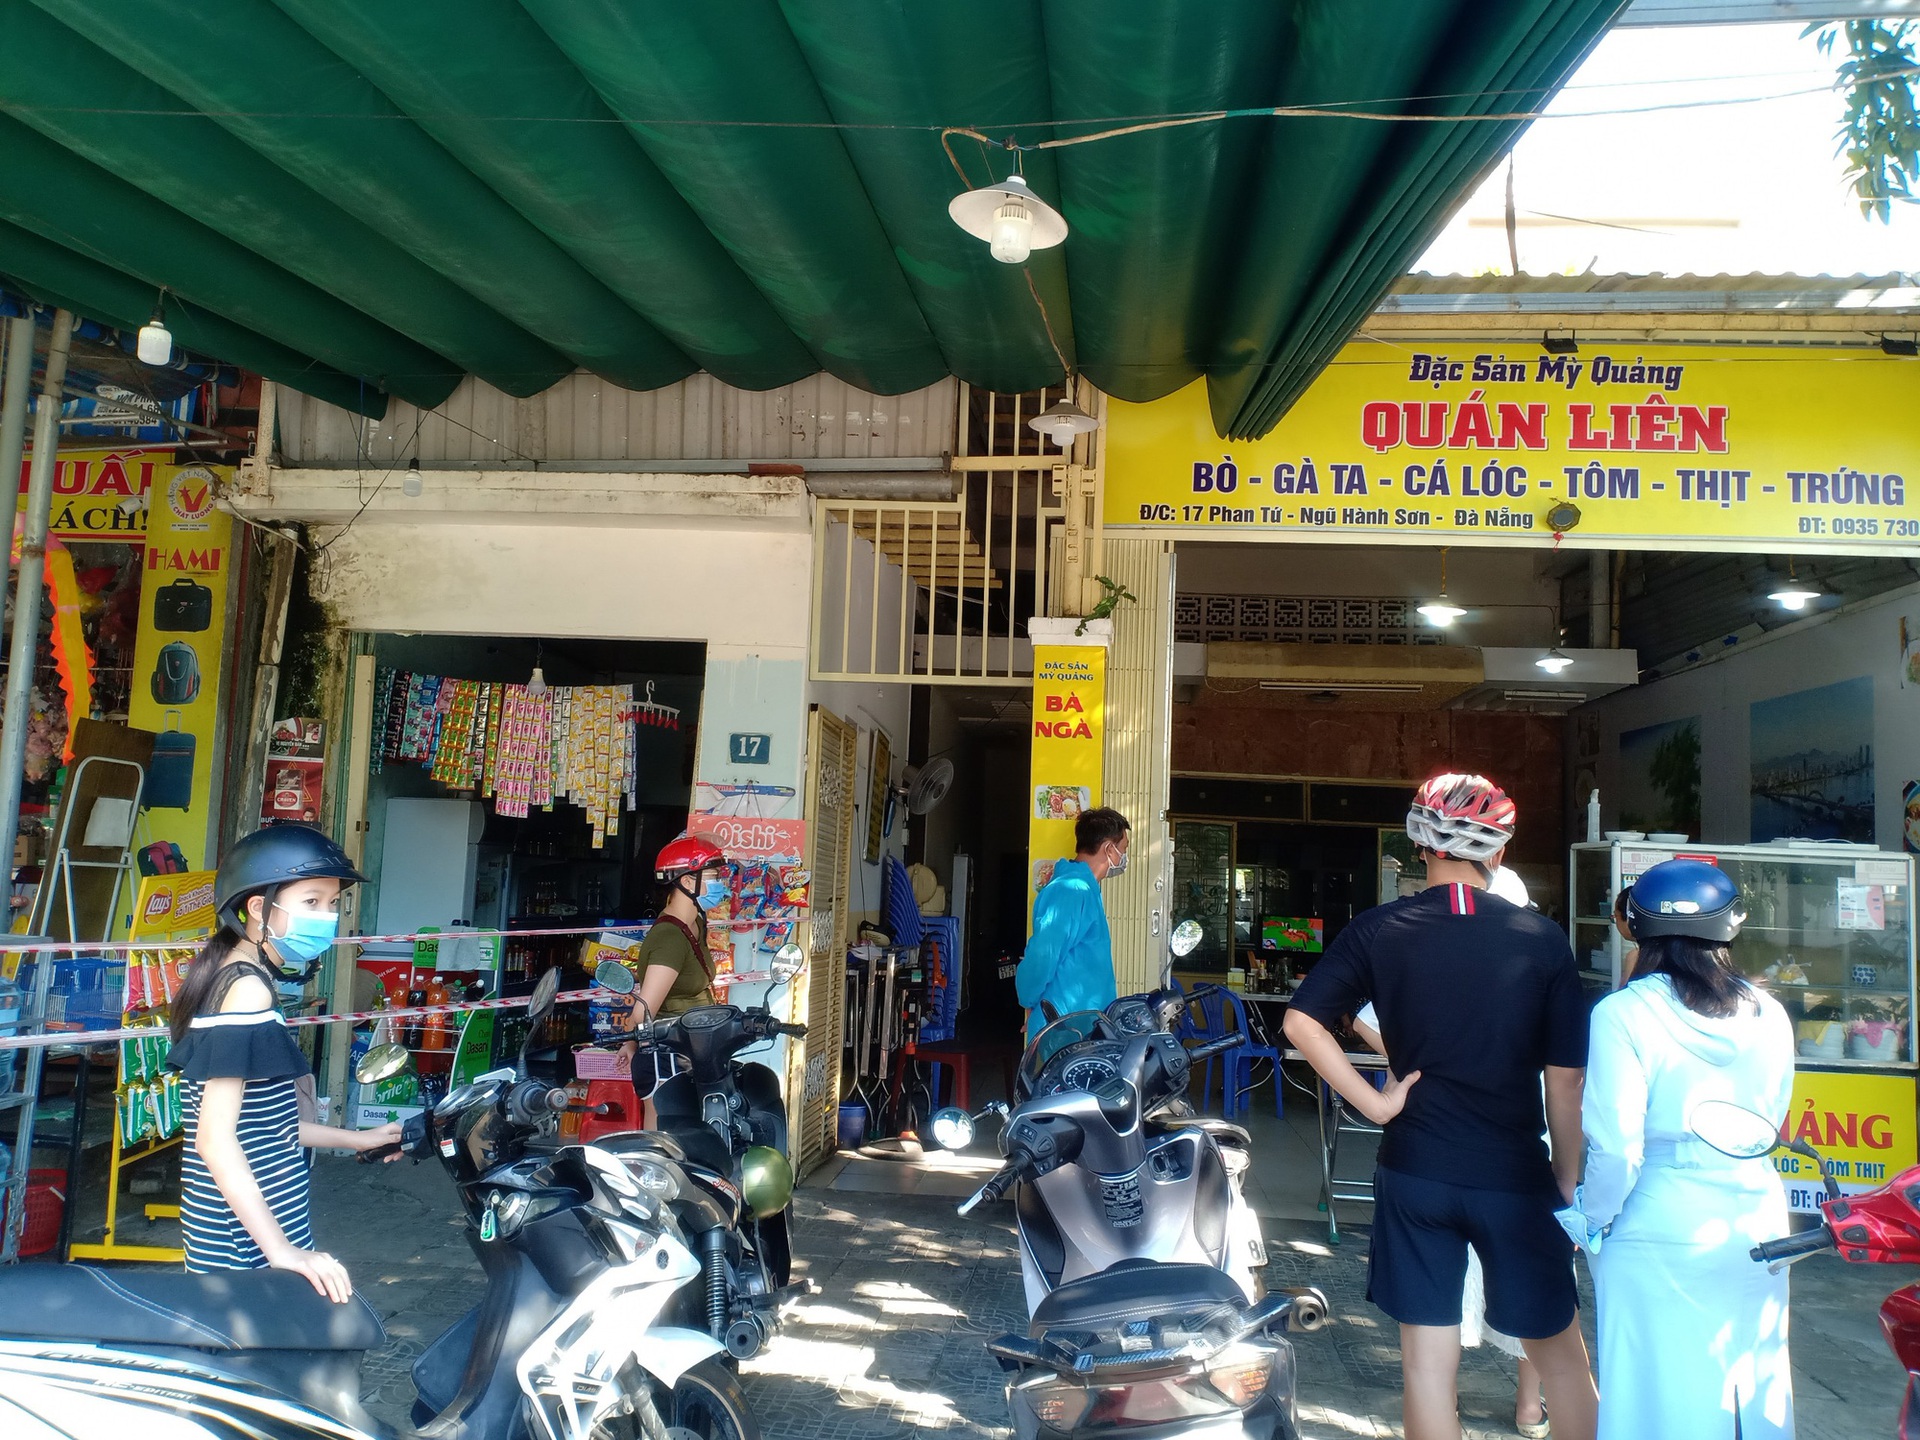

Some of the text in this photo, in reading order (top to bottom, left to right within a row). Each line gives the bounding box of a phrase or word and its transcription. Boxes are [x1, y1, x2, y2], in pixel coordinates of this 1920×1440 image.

[1409, 354, 1684, 391] Đặc Sản Mỳ Quảng
[1362, 390, 1728, 453] QUÁN LIÊN
[1193, 456, 1238, 493] BÒ
[1273, 457, 1318, 495] GÀ
[1330, 464, 1367, 495] TA
[1404, 459, 1450, 496] CÁ
[1462, 459, 1527, 498] LÓC
[1564, 461, 1639, 499] TÔM
[1677, 469, 1751, 508] THỊT
[1787, 467, 1905, 506] TRỨNG
[1139, 504, 1175, 521] Đ/C:
[1182, 505, 1202, 521] 17
[1209, 505, 1254, 523] Phan
[1260, 505, 1283, 523] Tứ
[1300, 506, 1336, 526] Ngũ
[1342, 507, 1389, 525] Hành
[1394, 510, 1429, 526] Sơn
[1454, 509, 1480, 527] Đà
[1485, 507, 1533, 529] Nẵng
[1799, 517, 1919, 537] ĐT: 0935 730
[148, 547, 221, 571] HAMI
[1046, 691, 1084, 713] BÀ
[1035, 718, 1093, 739] NGÀ
[738, 736, 761, 757] 17
[713, 821, 776, 850] Oishi
[1820, 1157, 1849, 1177] ÔM
[1855, 1163, 1885, 1182] THỊT
[1791, 1189, 1811, 1208] ĐT:
